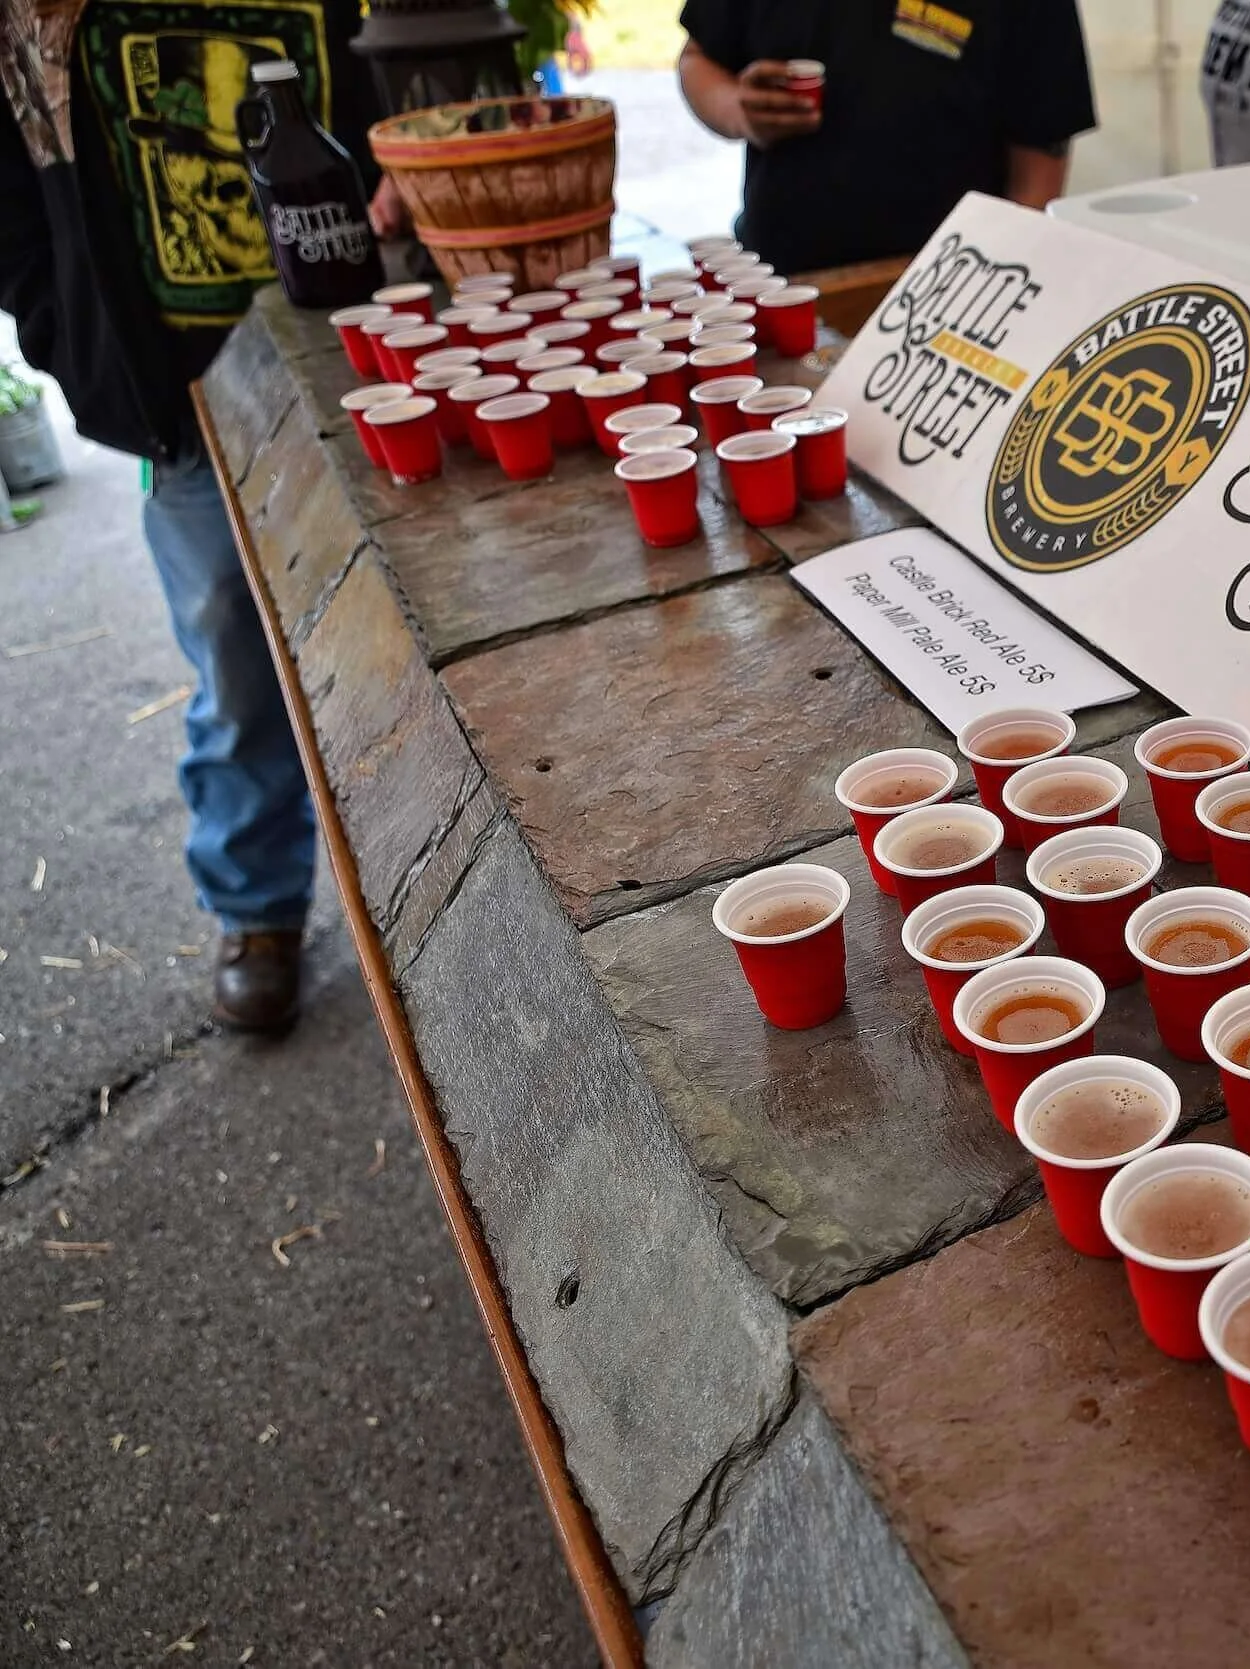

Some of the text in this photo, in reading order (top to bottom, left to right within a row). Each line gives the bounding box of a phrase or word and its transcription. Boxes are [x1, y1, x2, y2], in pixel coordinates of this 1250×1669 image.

[878, 233, 1042, 350] BATTLE
[864, 323, 1012, 465] STREET
[1072, 295, 1206, 366] BATTLE
[1199, 303, 1245, 429] STREET
[1002, 485, 1087, 551] BREWERY
[845, 572, 891, 607] Paper
[880, 605, 920, 628] Mill
[902, 626, 943, 654] Pale
[932, 654, 968, 675] Ale
[889, 555, 936, 592] Castle
[928, 590, 974, 622] Brick
[960, 619, 1008, 644] Red
[990, 643, 1026, 666] Ale
